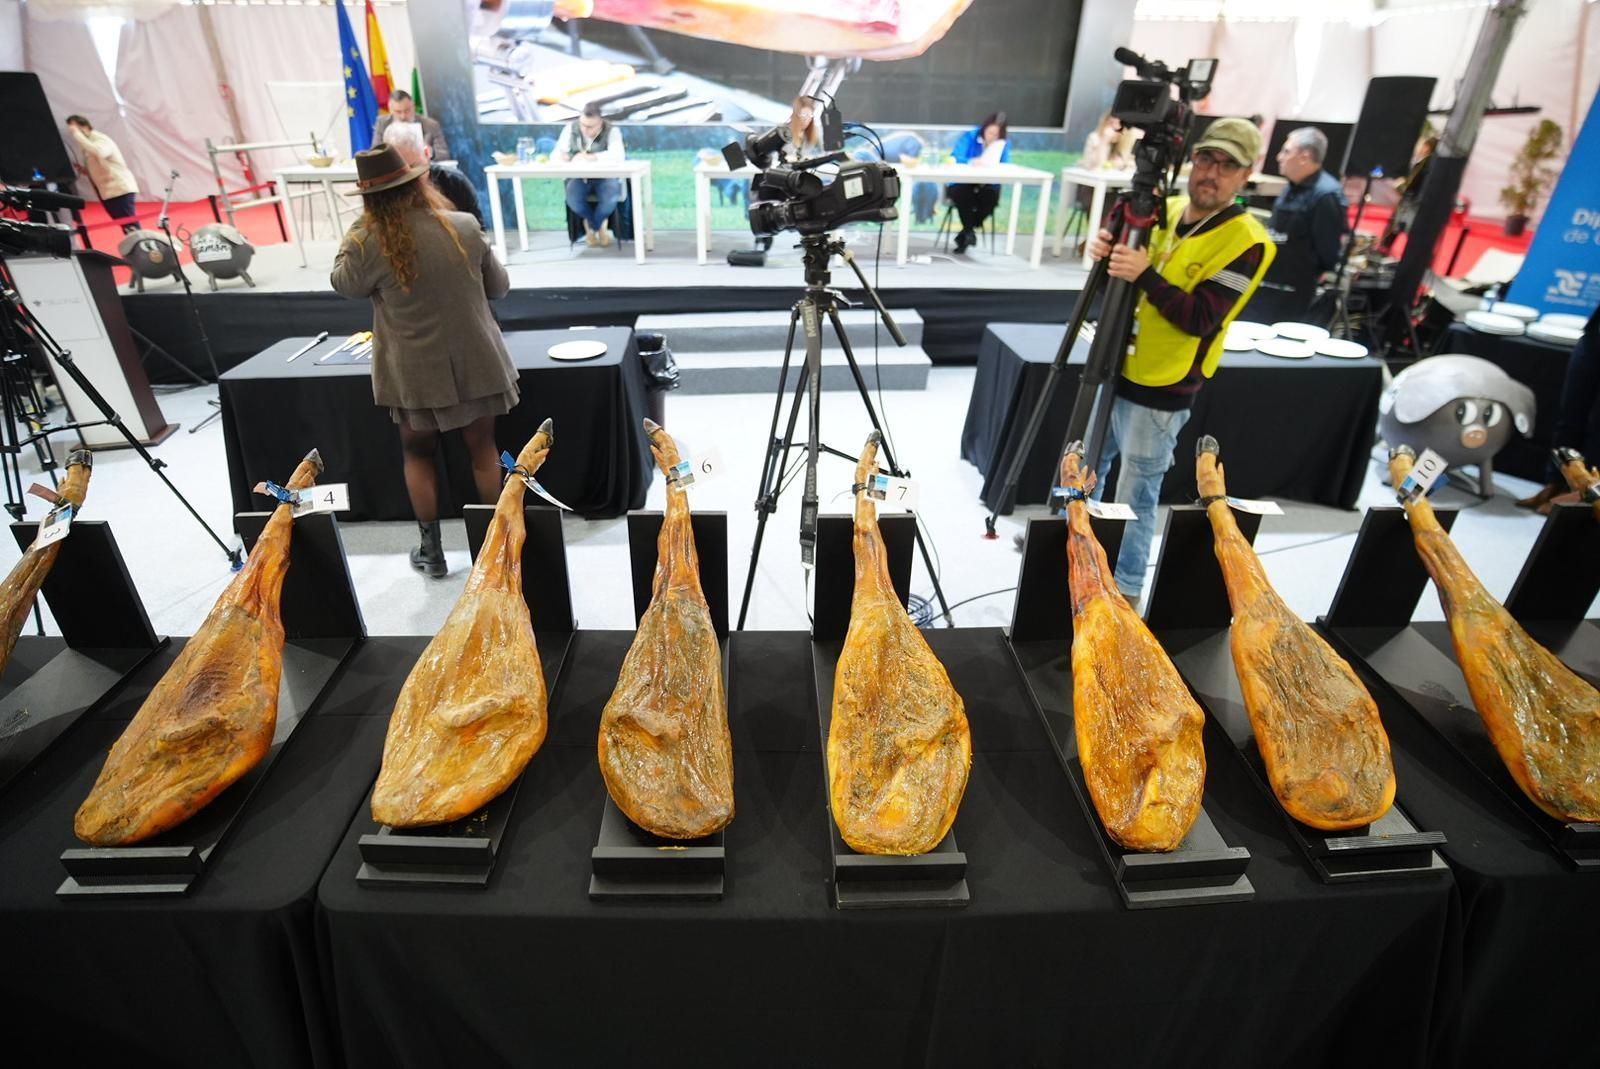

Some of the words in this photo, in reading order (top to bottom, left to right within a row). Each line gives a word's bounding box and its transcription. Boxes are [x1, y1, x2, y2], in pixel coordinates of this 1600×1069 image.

[1563, 229, 1590, 244] de
[701, 457, 713, 474] 6
[1416, 458, 1437, 480] 10
[323, 490, 336, 505] 4
[897, 485, 908, 501] 7
[44, 527, 61, 539] 3
